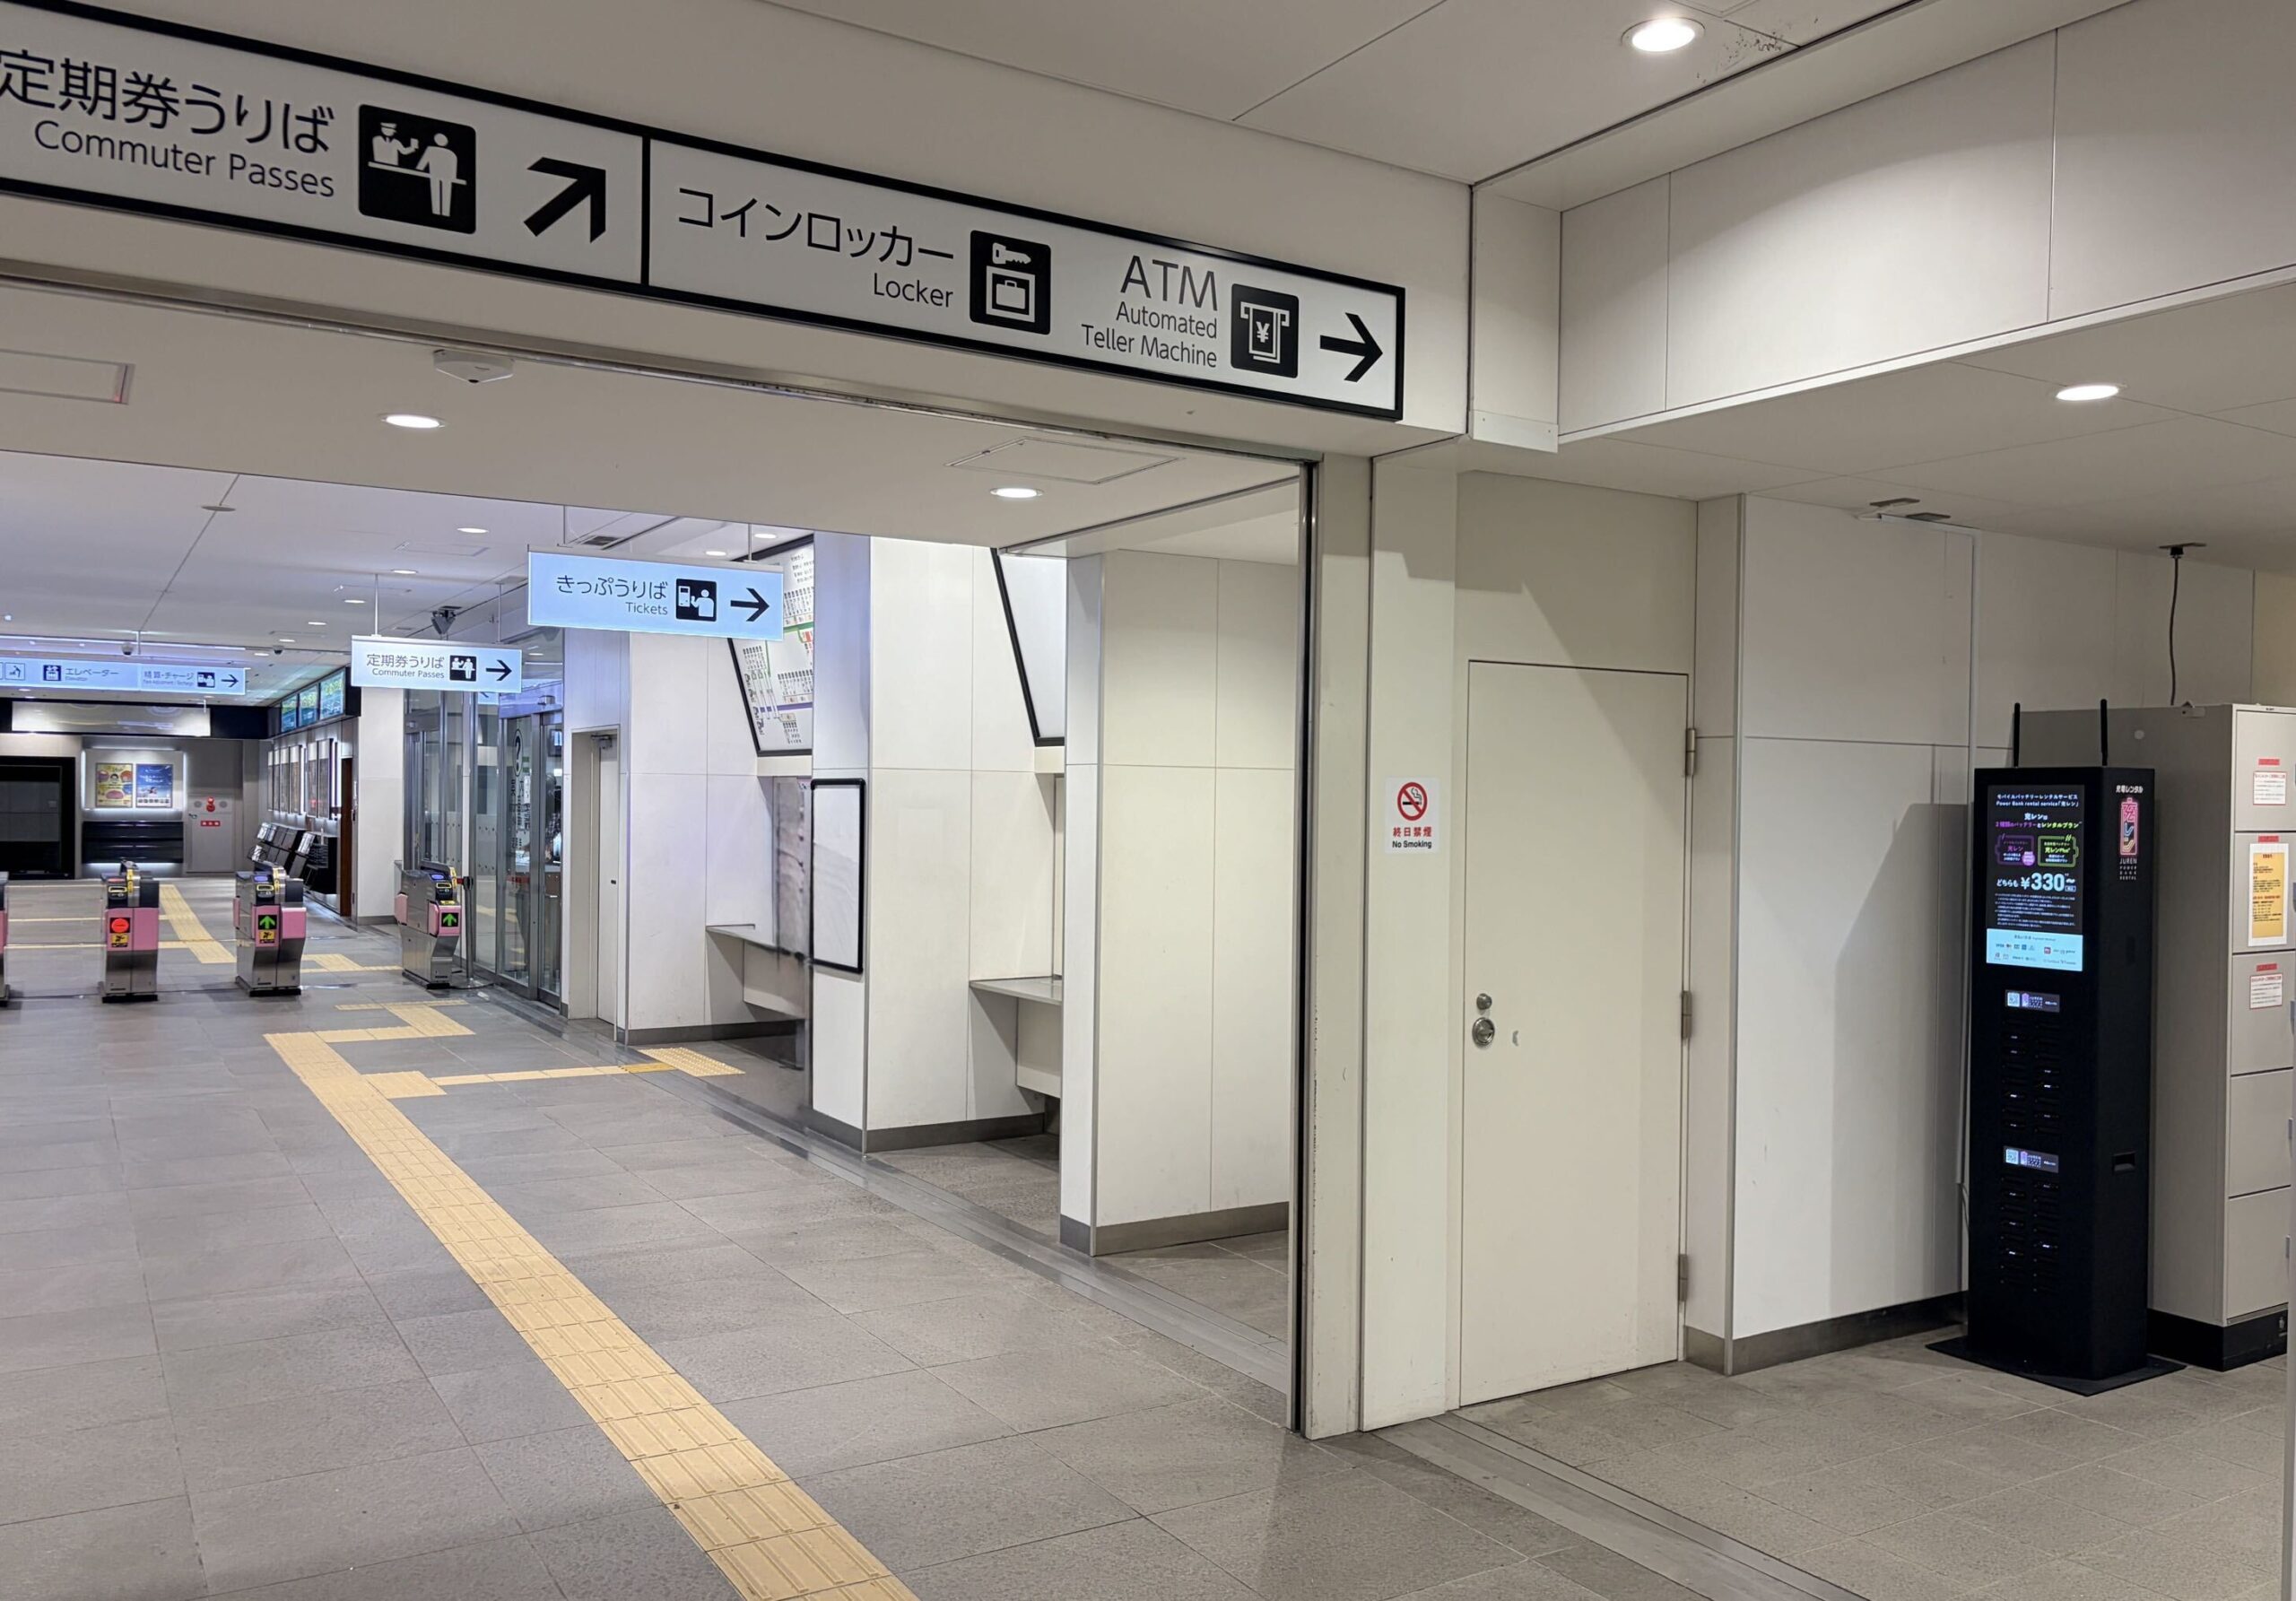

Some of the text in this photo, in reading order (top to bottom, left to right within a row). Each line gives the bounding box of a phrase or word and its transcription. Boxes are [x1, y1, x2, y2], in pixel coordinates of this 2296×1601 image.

[0, 48, 335, 153] 定期券うりば
[34, 119, 335, 197] Commuter Passes
[678, 187, 954, 266] コインロッカー
[873, 273, 953, 308] Locker
[1120, 255, 1218, 311] ATM
[1116, 301, 1217, 339] Automated
[1081, 324, 1217, 368] Teller Machine
[556, 575, 668, 599] きっぷうりば
[625, 602, 668, 615] Tickets
[65, 668, 120, 677] エレベーター
[366, 653, 445, 669] 定期券うりば
[372, 668, 445, 679] Commuter Passes
[1392, 826, 1432, 838] 終日禁煙
[1403, 840, 1432, 849] Smoking
[1996, 879, 2019, 888] どちらも
